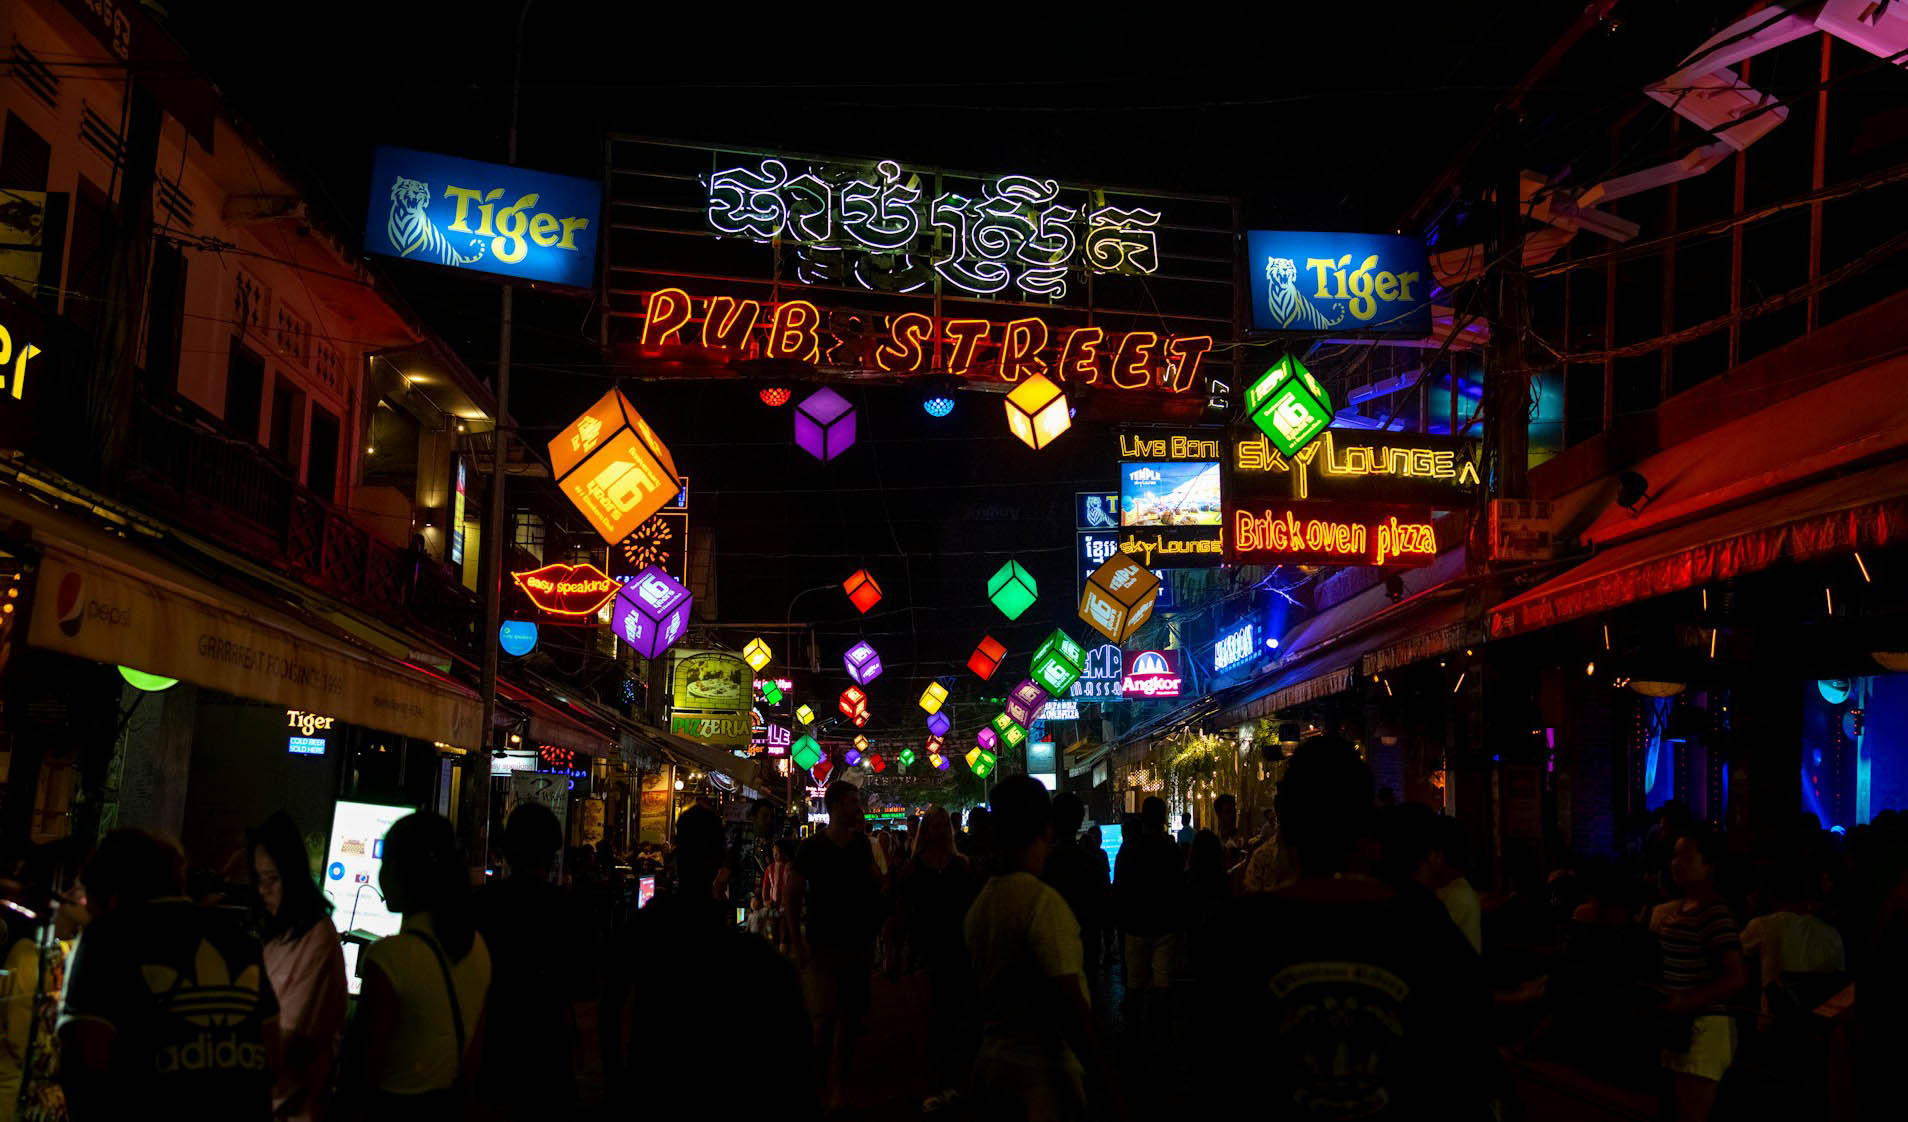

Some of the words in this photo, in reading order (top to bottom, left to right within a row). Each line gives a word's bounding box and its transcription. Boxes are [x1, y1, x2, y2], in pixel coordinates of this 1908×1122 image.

[444, 185, 590, 264] Tiger
[1306, 254, 1420, 320] Tiger
[641, 287, 820, 364] PUB
[876, 312, 1213, 393] STREET
[1119, 434, 1166, 457] Live
[1171, 435, 1219, 458] Ban
[593, 460, 656, 513] 16
[1236, 509, 1305, 551] Brick
[1306, 519, 1367, 554] oven
[1377, 516, 1437, 566] pizza
[527, 577, 554, 593] easy
[556, 580, 611, 596] speaking
[1122, 675, 1182, 695] Angkor
[286, 710, 335, 736] Tiger
[672, 717, 752, 739] PIZZERIA
[289, 745, 307, 753] SOLD
[307, 747, 325, 755] HERE
[290, 737, 308, 745] COLD
[308, 738, 326, 746] BEER
[154, 1031, 266, 1073] adidas
